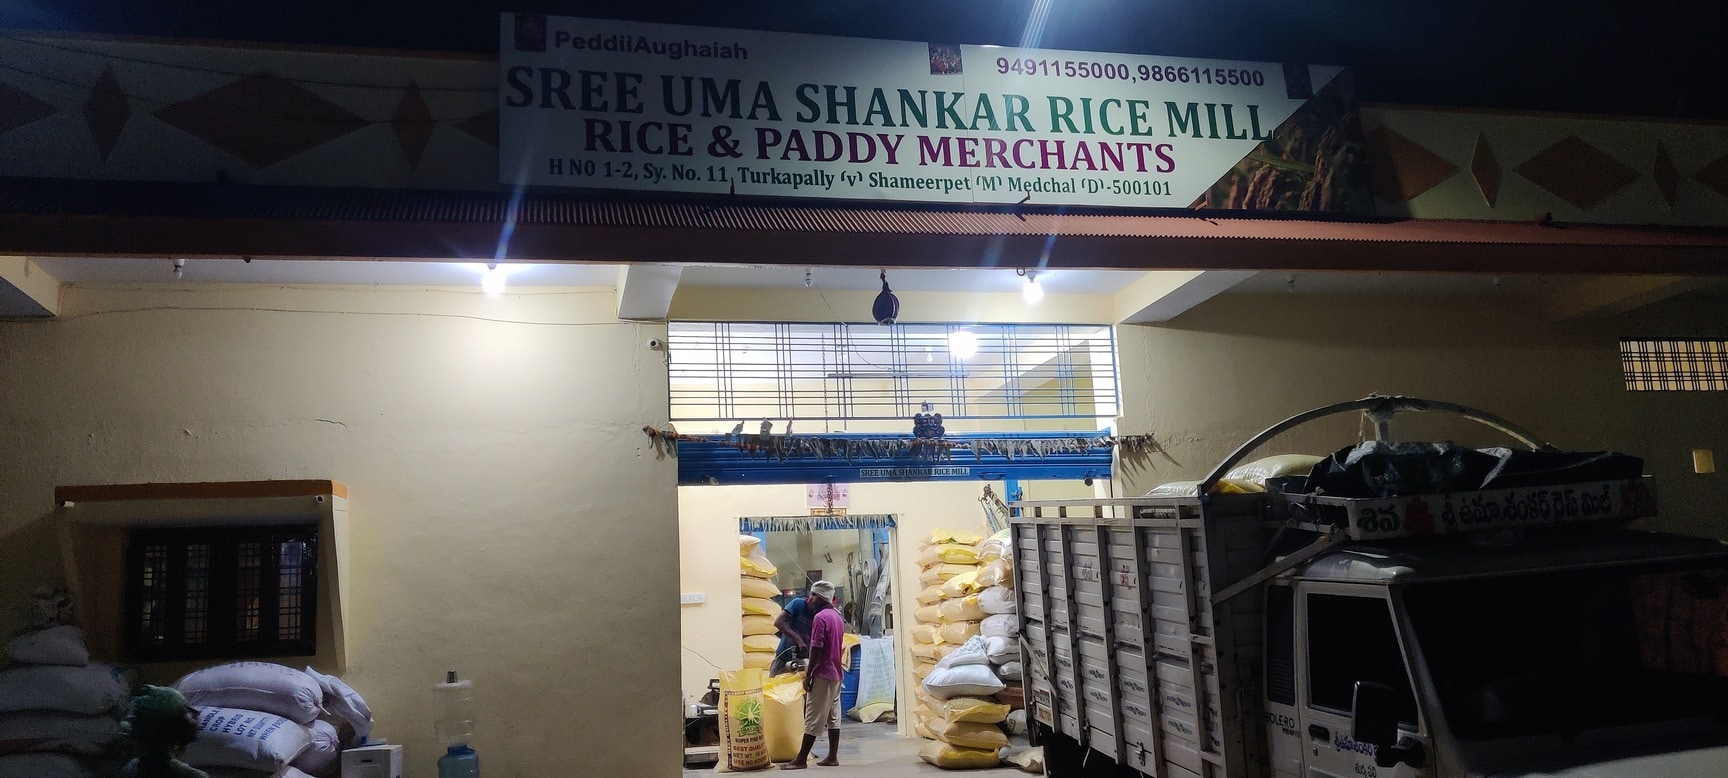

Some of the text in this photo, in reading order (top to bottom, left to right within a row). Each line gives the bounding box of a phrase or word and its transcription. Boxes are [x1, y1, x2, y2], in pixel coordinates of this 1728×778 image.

[554, 30, 748, 61] PeddiiAughaiah
[996, 57, 1265, 87] 9491155000,9866115500
[506, 65, 1276, 142] SREE UMA SHANKAR RICE MILL
[583, 118, 1176, 174] RICE & PADDY MERCHANTS
[549, 158, 563, 176] H
[603, 161, 639, 182] 1-2,
[643, 162, 667, 184] Sy.
[671, 164, 701, 182] No.
[737, 166, 835, 191] Turkapally
[868, 171, 972, 195] Shameerpet
[1007, 176, 1076, 194] Medchal
[861, 467, 969, 477] SREE UMA SHANKAR RICE MILL
[208, 715, 226, 732] CROP
[1265, 711, 1295, 729] BOLERO
